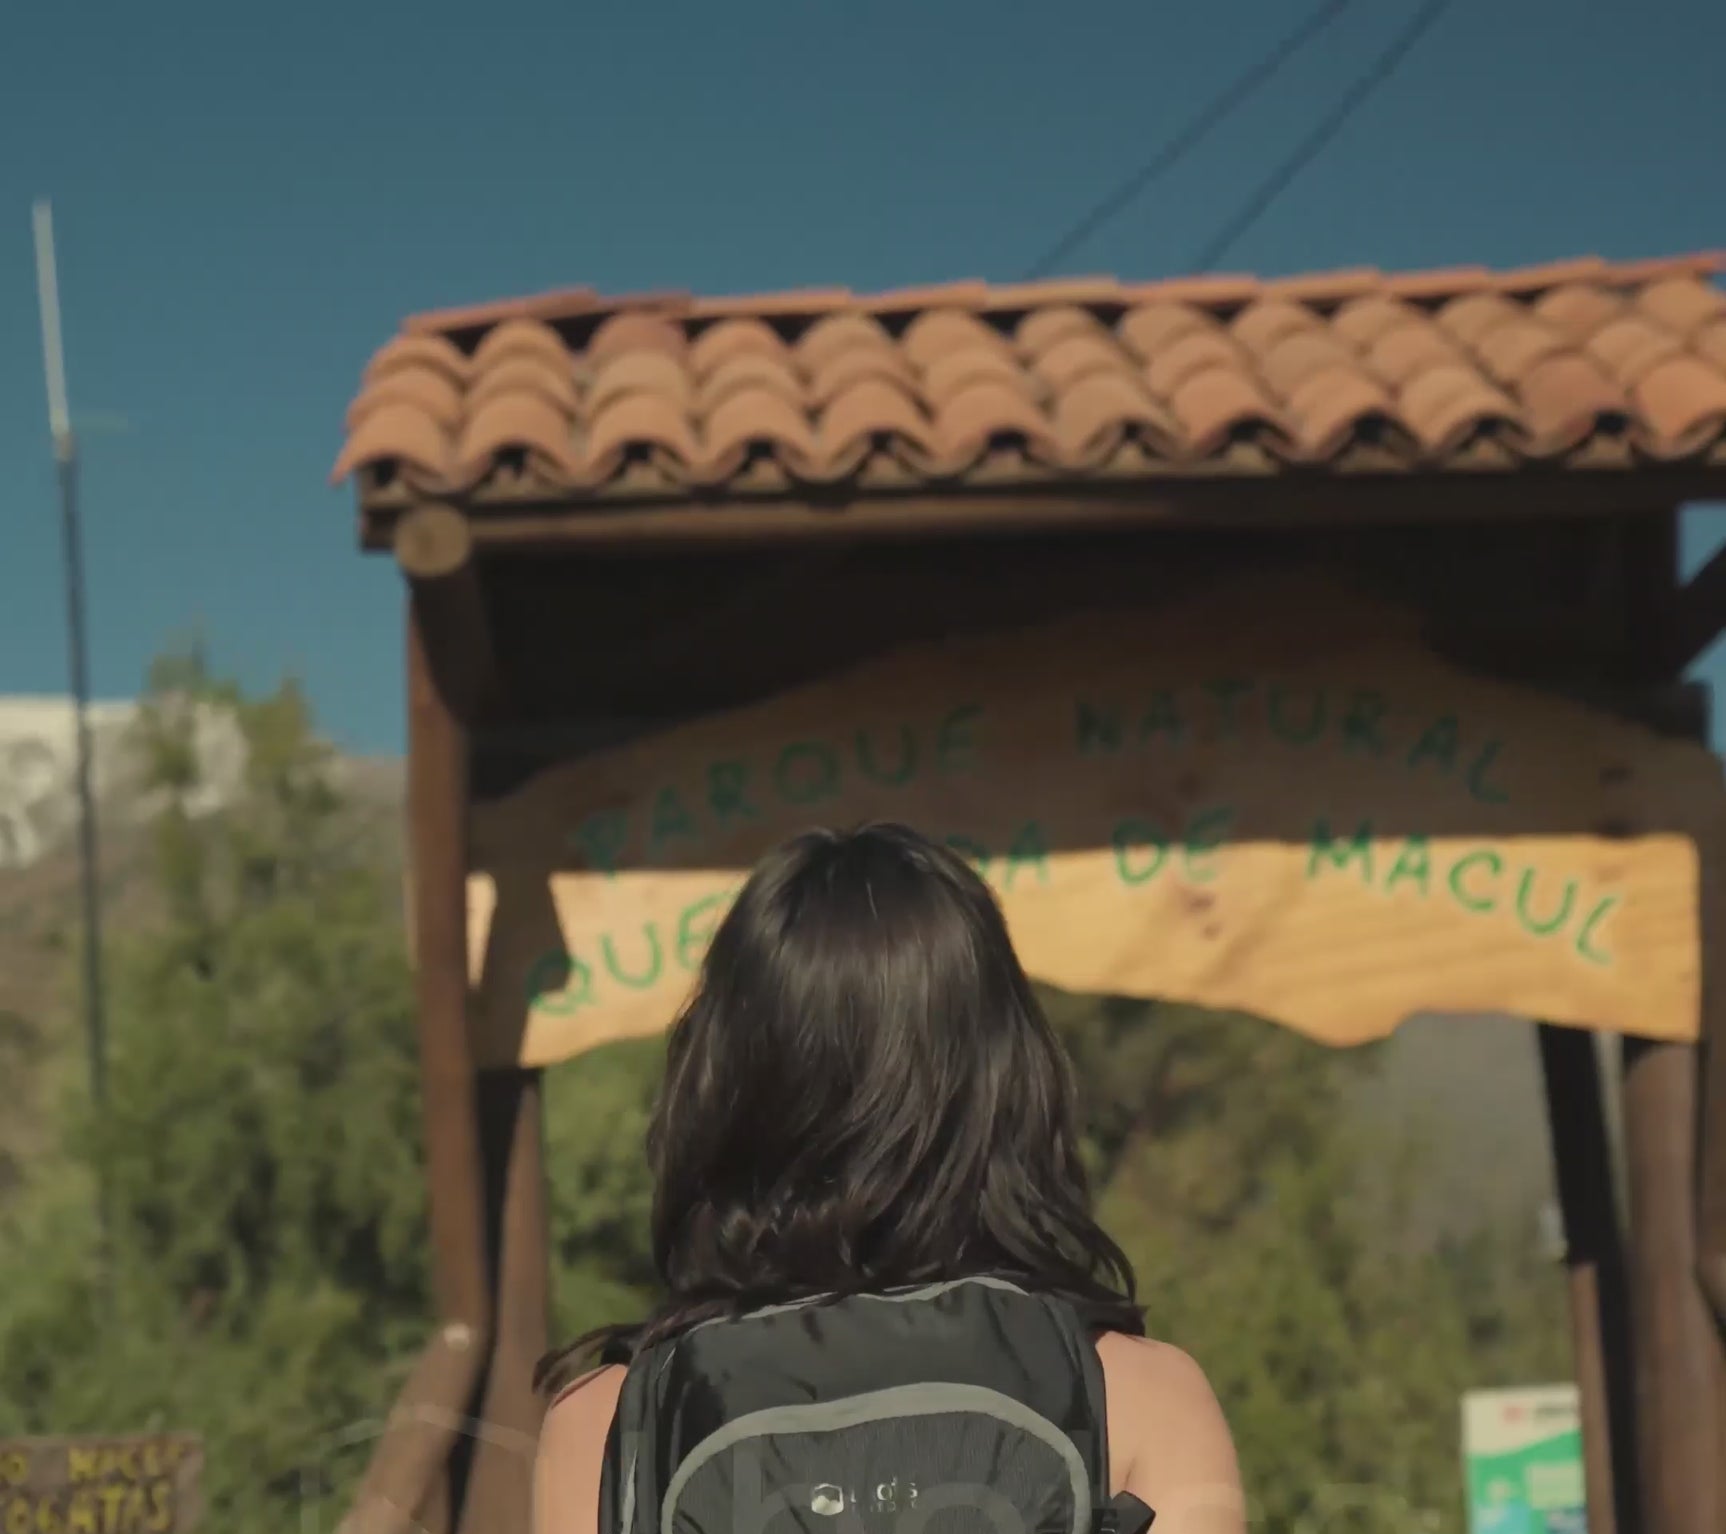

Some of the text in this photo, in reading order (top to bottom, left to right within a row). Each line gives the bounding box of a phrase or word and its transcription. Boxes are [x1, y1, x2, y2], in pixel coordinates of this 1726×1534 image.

[570, 678, 1510, 882] PARQUE NATURAL
[1111, 806, 1237, 888] DE
[1305, 818, 1620, 965] MACUL
